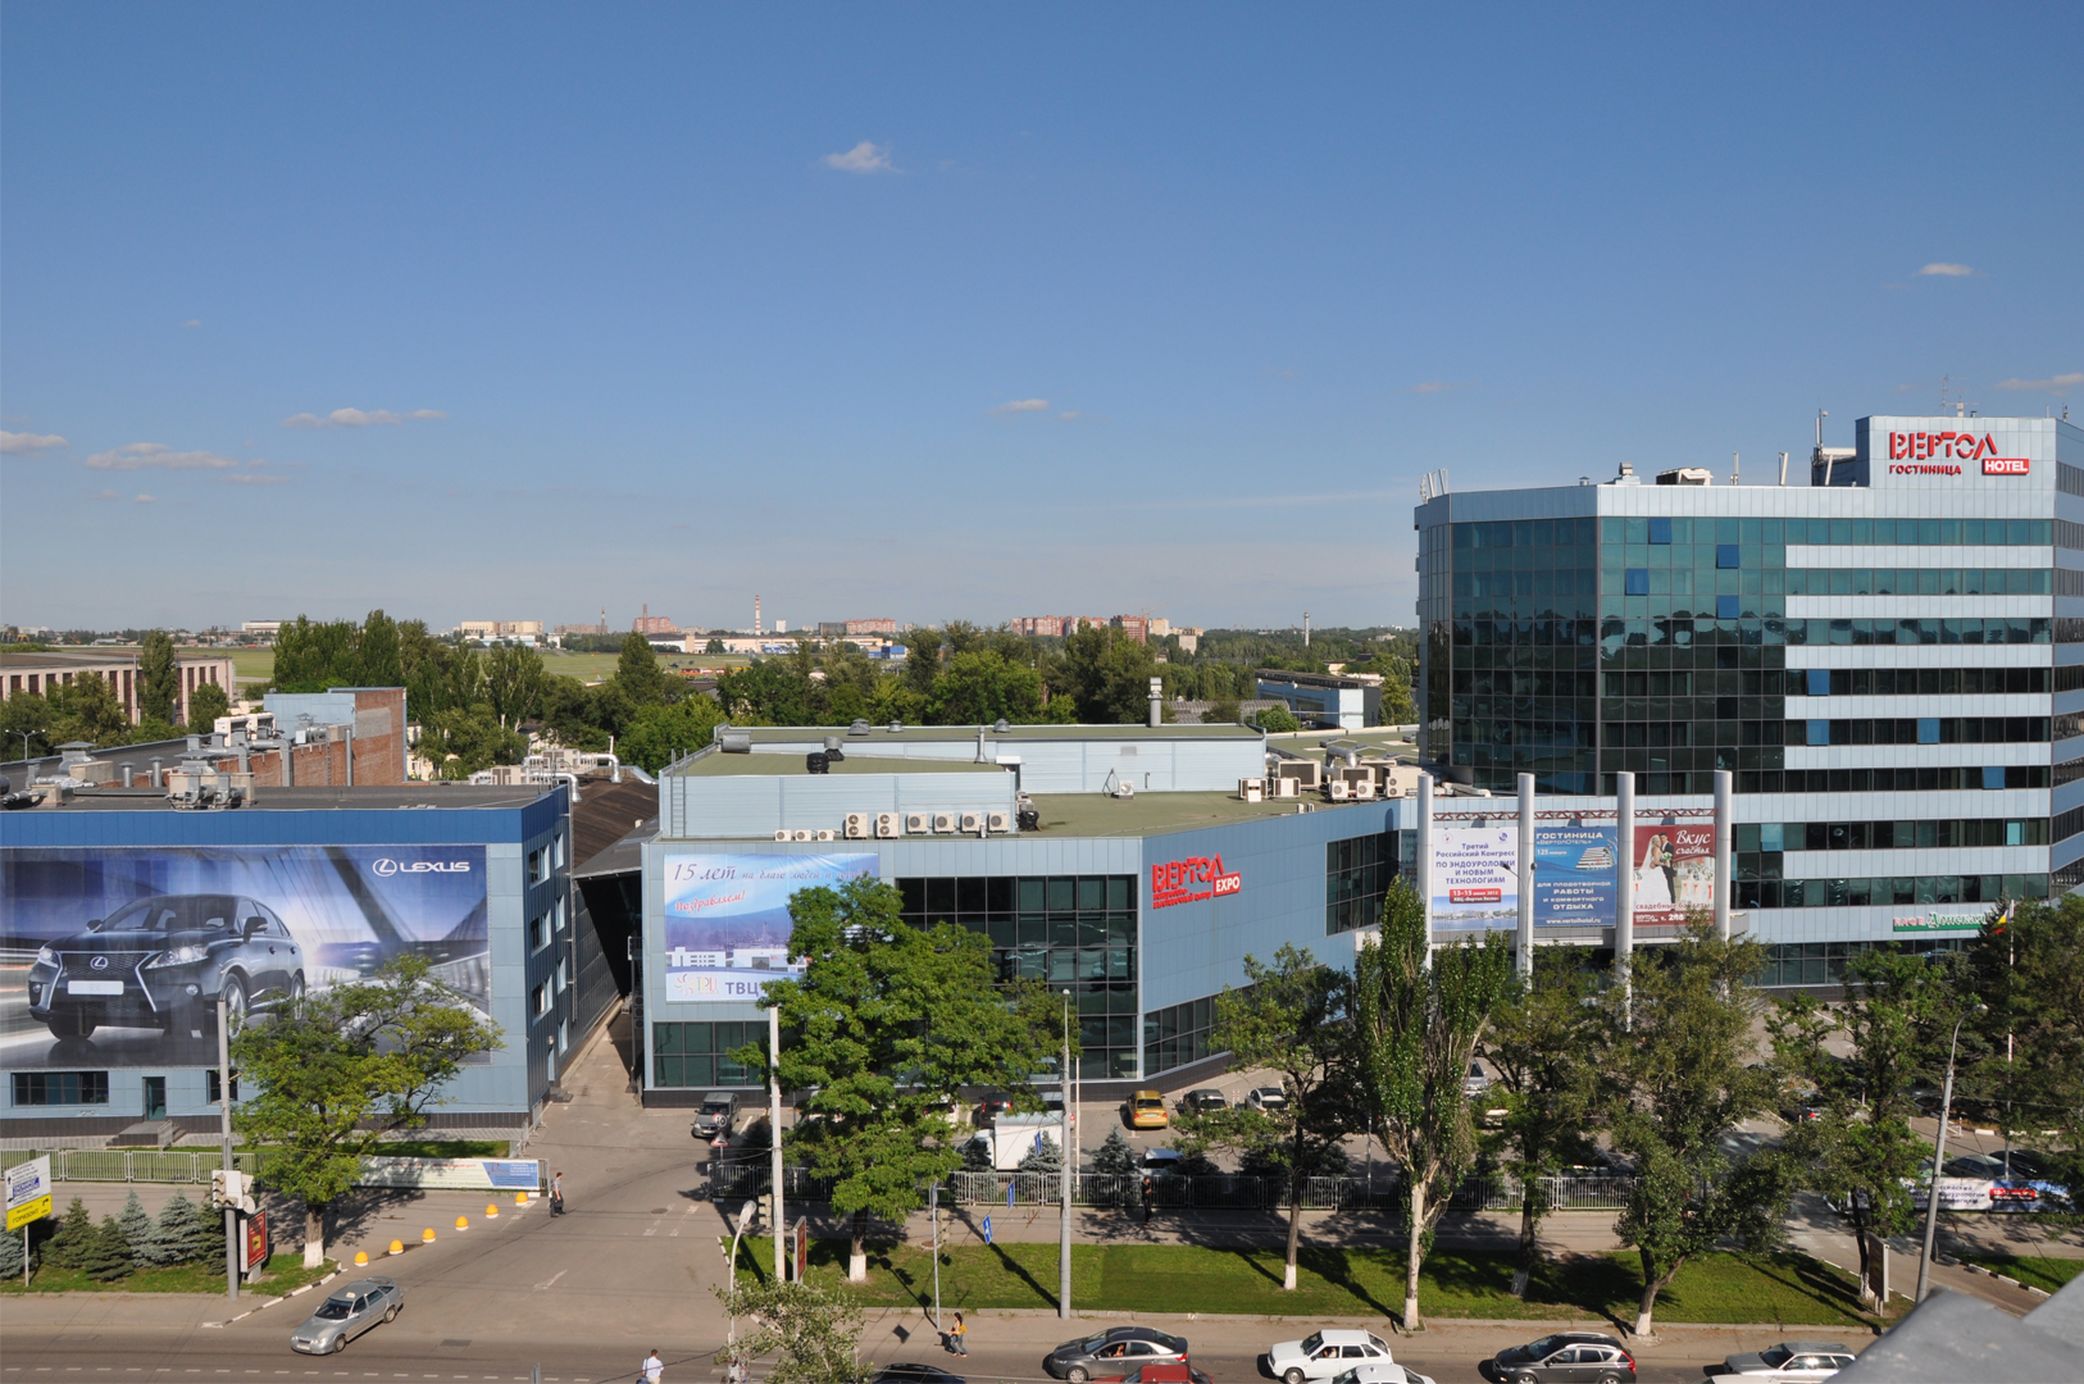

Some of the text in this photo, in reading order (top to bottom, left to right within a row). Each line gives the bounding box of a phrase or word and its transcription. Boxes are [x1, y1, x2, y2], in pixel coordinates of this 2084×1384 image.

[1889, 432, 1998, 460] ВЕРТОЛ
[1889, 464, 1962, 476] ГОСТИНИЦА
[1984, 460, 2028, 472] HOTEL
[1676, 830, 1711, 846] Вкус
[1436, 850, 1515, 858] Российский Конгресс
[399, 861, 471, 873] LEXUS
[674, 863, 697, 881] 15
[700, 865, 737, 880] лет
[1152, 852, 1224, 893] ВЕРТОЛ
[1215, 876, 1240, 893] EXPO
[1446, 877, 1506, 885] ТЕХНОЛОГИЯМ
[725, 981, 759, 997] ТВЦ
